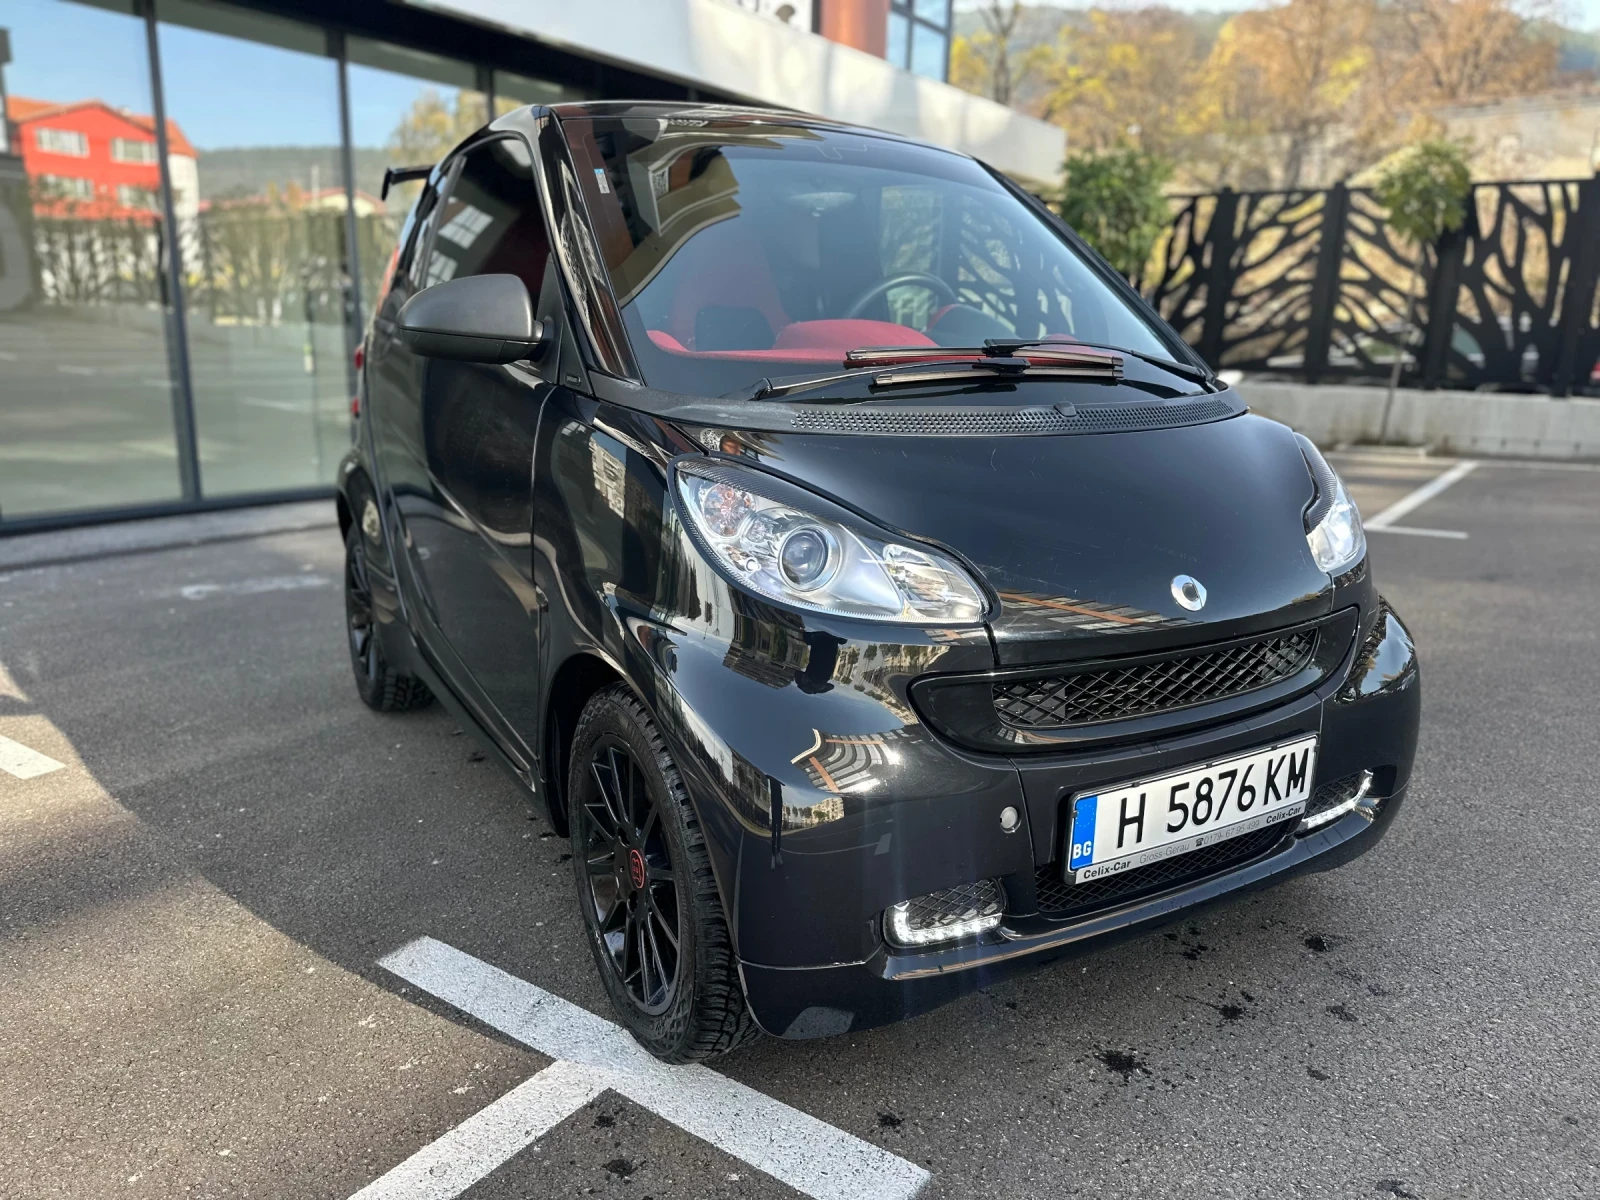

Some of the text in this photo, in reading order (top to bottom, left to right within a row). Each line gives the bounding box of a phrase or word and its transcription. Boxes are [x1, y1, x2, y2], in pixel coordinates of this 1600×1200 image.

[1117, 747, 1310, 849] H 5876 KM
[1072, 840, 1093, 860] BG
[1083, 859, 1132, 880] Celix-Car
[1139, 843, 1191, 864] Gross-Gerau
[1265, 806, 1302, 824] Celix-Car
